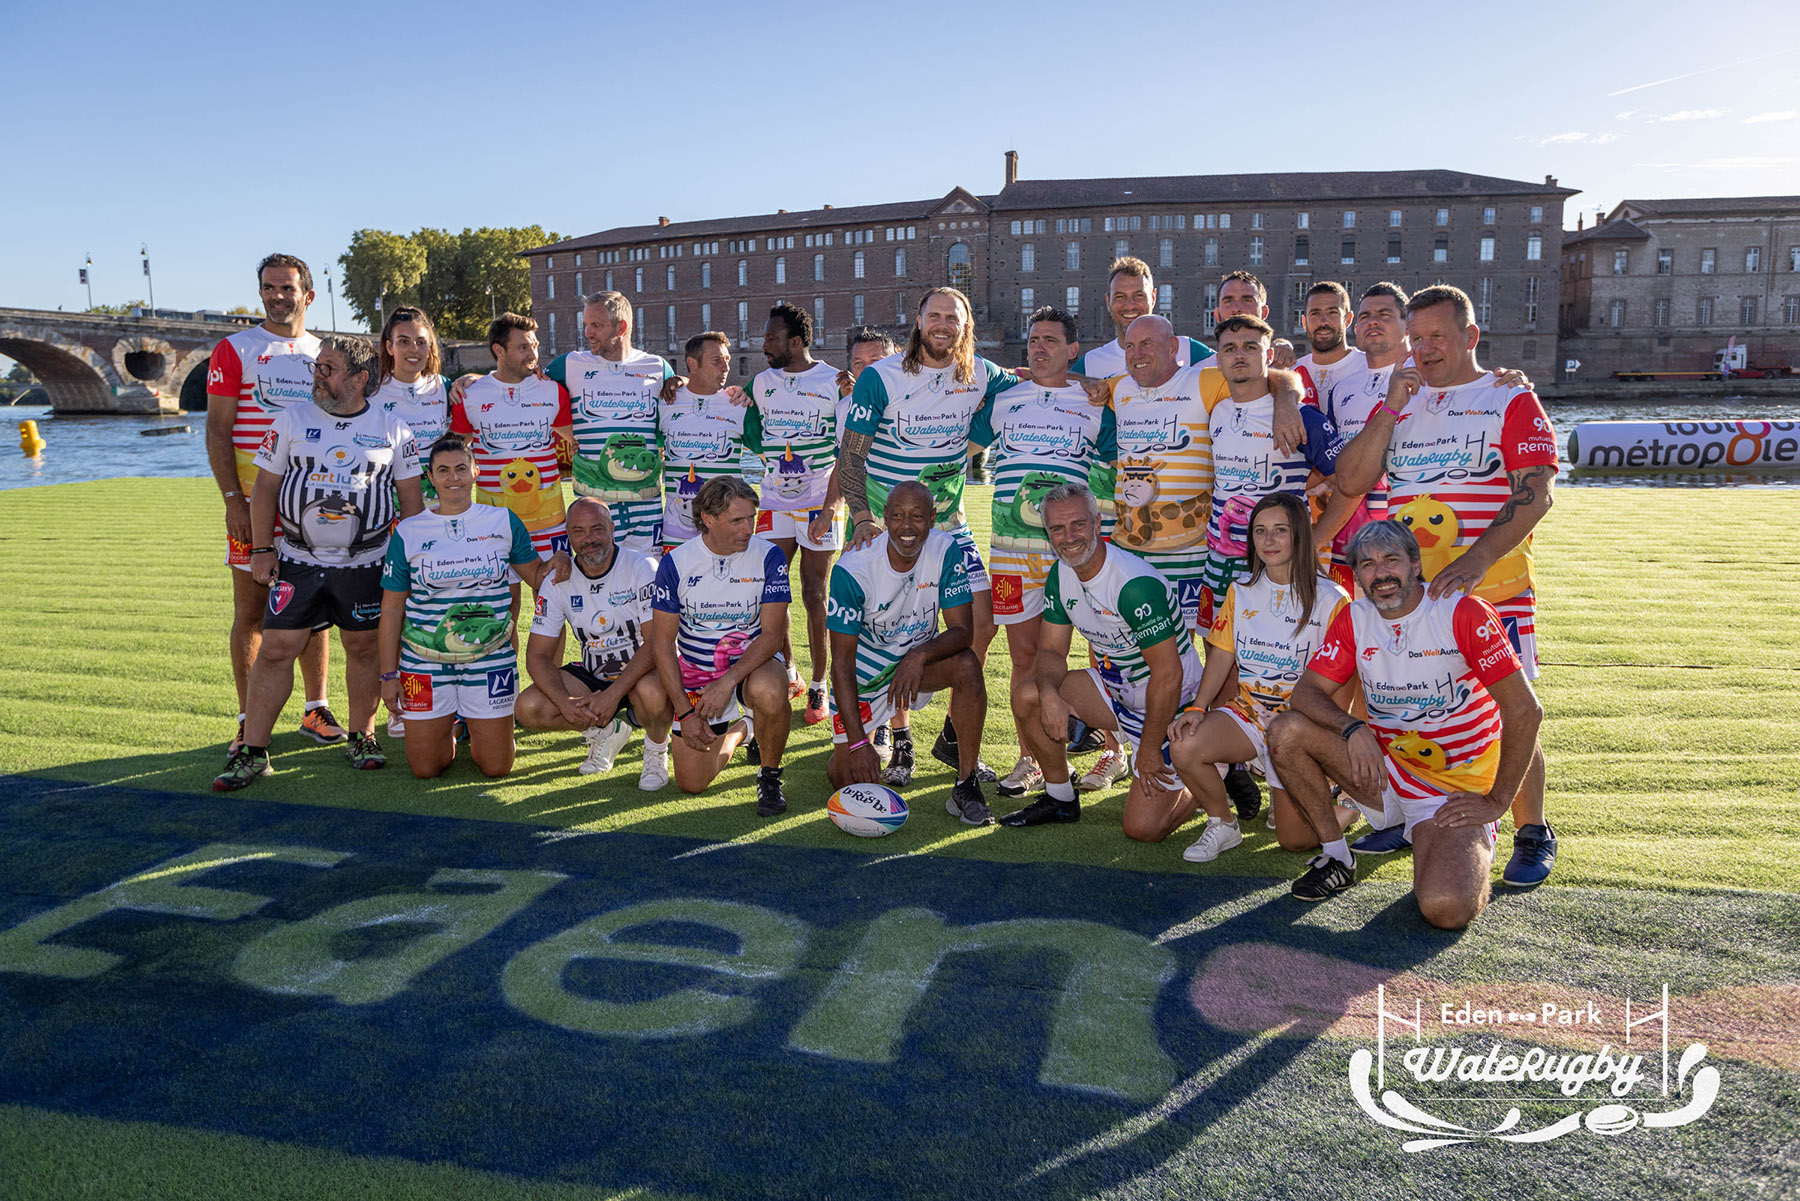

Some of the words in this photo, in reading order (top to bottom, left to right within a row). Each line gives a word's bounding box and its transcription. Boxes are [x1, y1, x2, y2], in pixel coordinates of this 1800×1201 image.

[1567, 360, 1574, 368] P
[208, 367, 224, 386] pi
[267, 387, 313, 401] WateRug
[589, 400, 647, 411] WateRugby
[850, 403, 873, 422] rpi
[766, 419, 812, 430] WateRugby
[905, 423, 965, 437] WateRugby
[1533, 417, 1551, 433] 90
[488, 429, 544, 442] WateRugby
[1008, 432, 1074, 448] WateRugby
[1402, 441, 1424, 449] Eden
[1436, 436, 1457, 445] Park
[672, 440, 720, 452] WateRugby
[1518, 442, 1555, 455] Remp
[1234, 455, 1249, 463] Park
[1391, 450, 1472, 468] WateRugby
[310, 473, 362, 485] artlux
[383, 561, 393, 578] pi
[429, 565, 495, 580] WateRugby
[655, 585, 670, 602] pi
[765, 584, 790, 594] Remp
[944, 583, 971, 598] Remp
[1044, 595, 1055, 611] pi
[693, 611, 752, 622] WateRugby
[827, 597, 863, 625] Orpi
[1134, 603, 1152, 620] 90
[1136, 618, 1156, 630] mutuelle
[1476, 620, 1499, 641] 90
[1096, 631, 1108, 639] Park
[1250, 638, 1266, 646] Eden
[1275, 641, 1291, 651] Park
[1482, 639, 1504, 656] mutuel
[1239, 649, 1300, 671] WateRugby
[1478, 645, 1512, 672] Remp
[1376, 682, 1395, 691] Eden
[1408, 679, 1429, 691] Park
[1371, 693, 1447, 709] WateRugby
[0, 843, 1179, 1101] Eden
